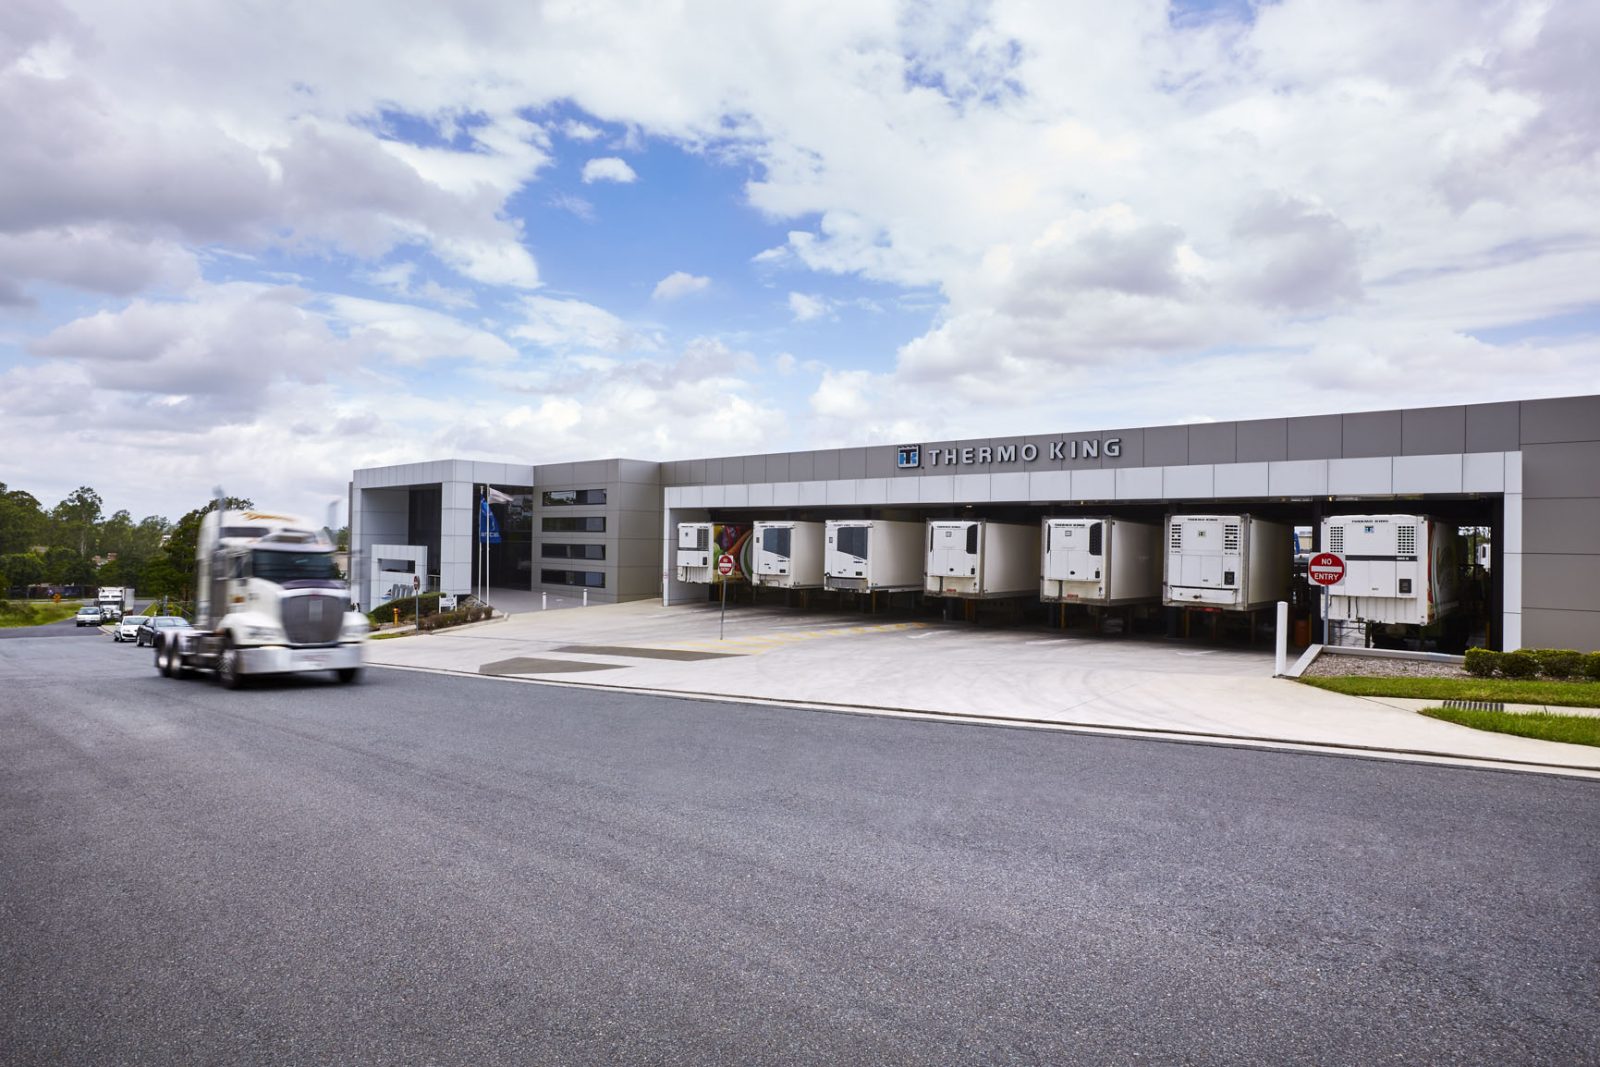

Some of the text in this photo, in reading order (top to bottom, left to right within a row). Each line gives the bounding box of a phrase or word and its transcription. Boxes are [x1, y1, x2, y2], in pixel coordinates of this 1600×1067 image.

[928, 438, 1121, 466] THERMO KING
[1314, 573, 1339, 581] ENTRY
